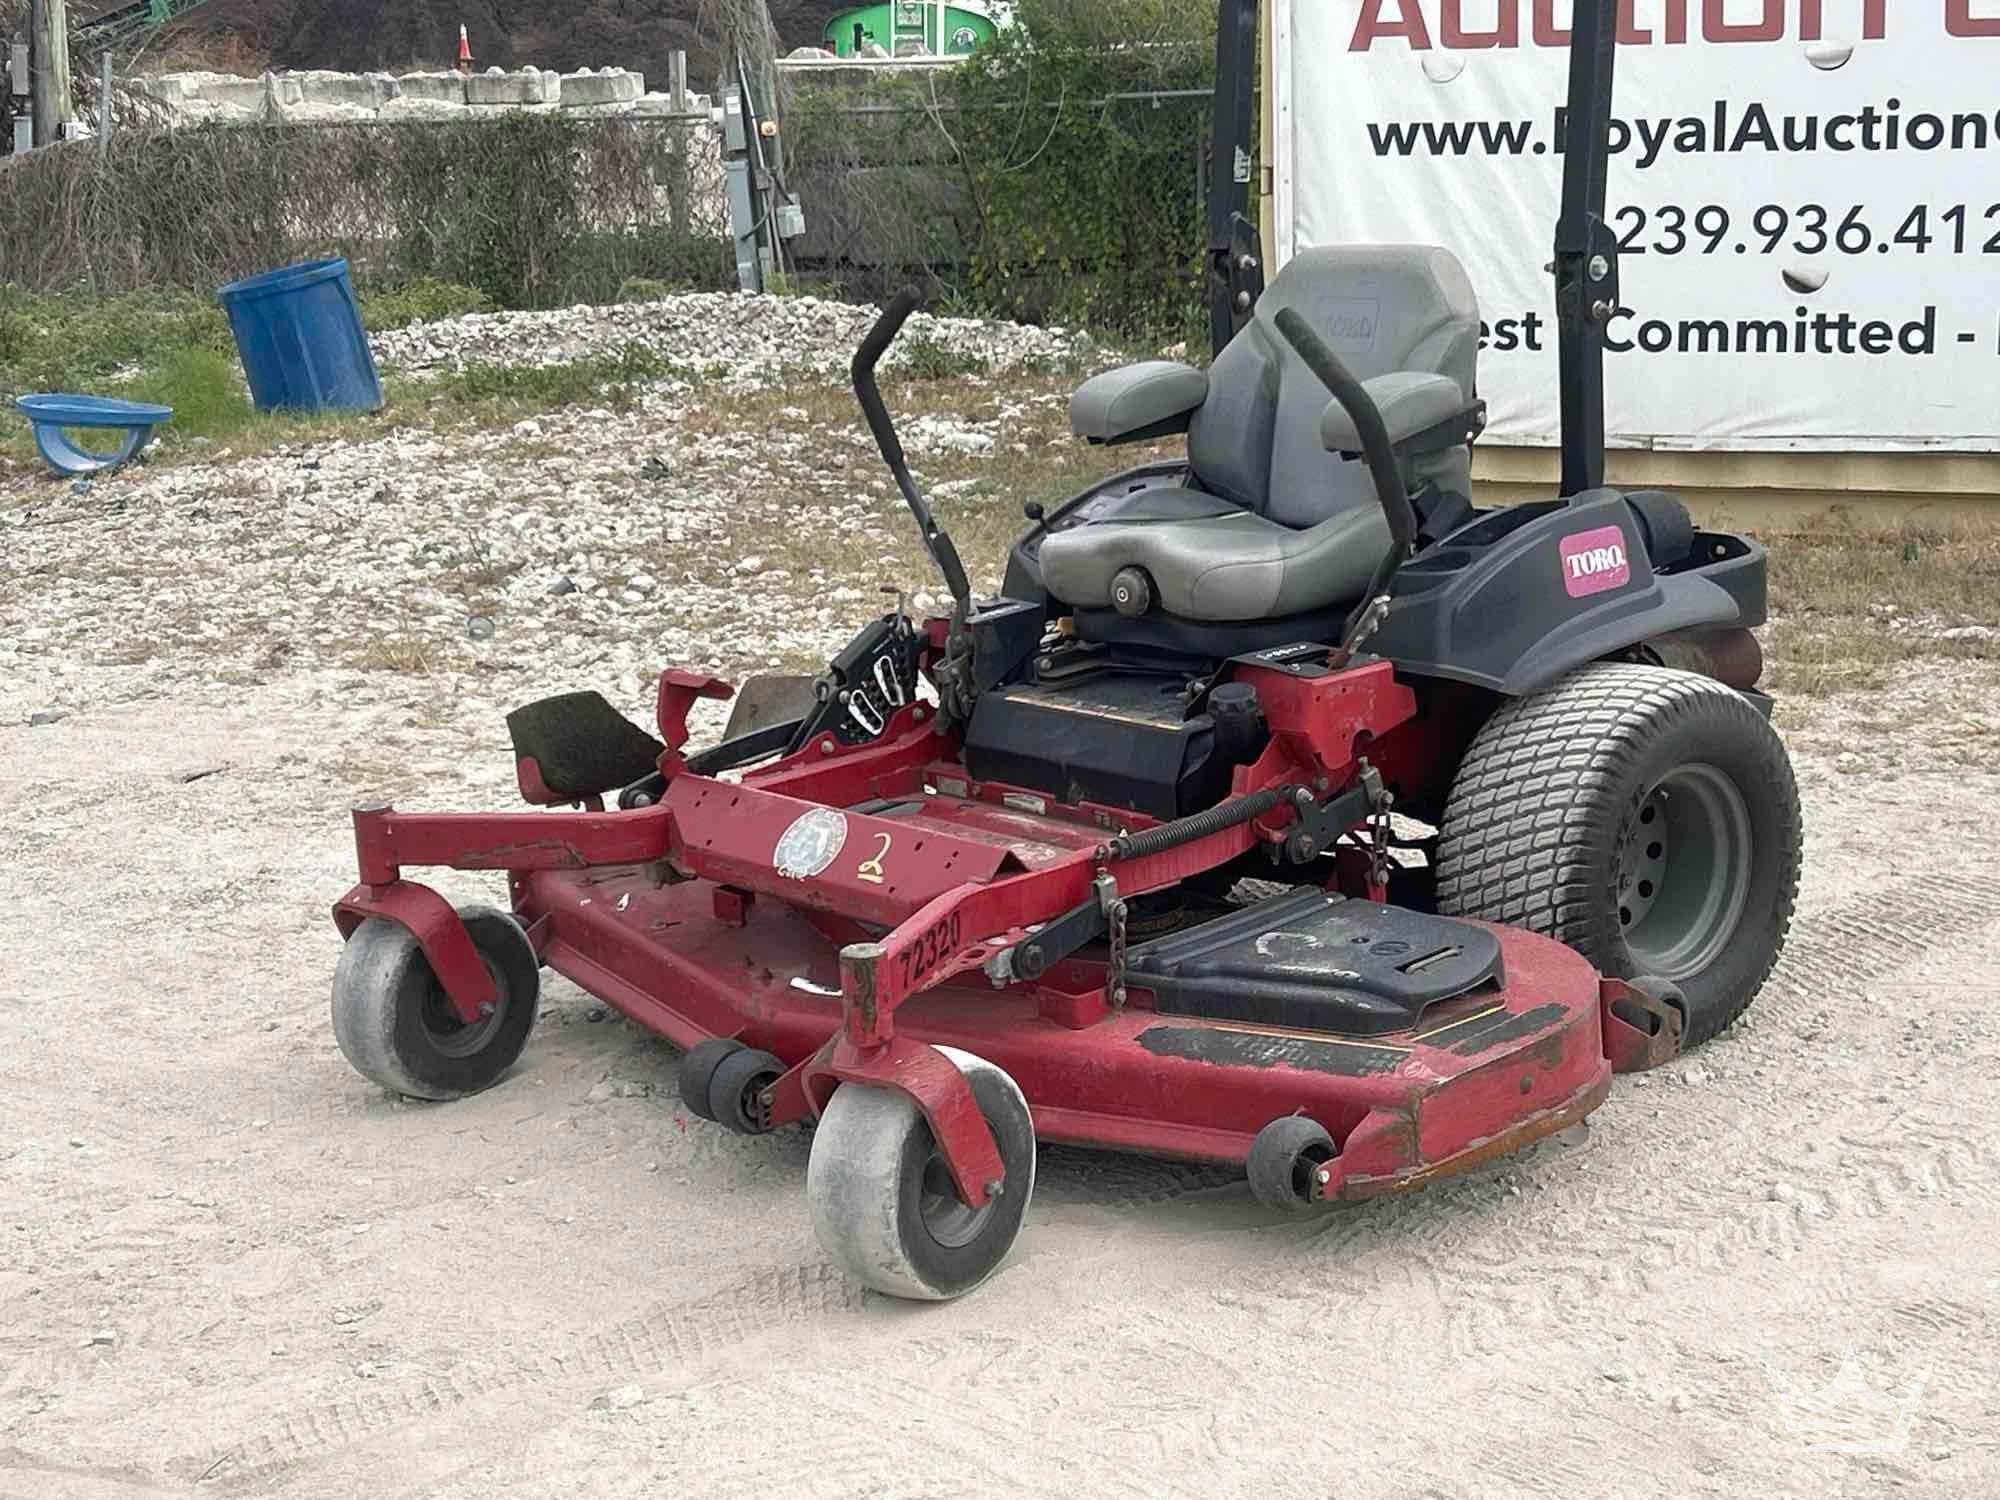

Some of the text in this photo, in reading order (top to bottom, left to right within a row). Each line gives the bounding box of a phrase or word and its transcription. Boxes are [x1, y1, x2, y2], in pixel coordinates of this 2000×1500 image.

[1366, 98, 2000, 169] www.oyalAuction
[1602, 306, 1936, 354] Committed
[900, 910, 960, 990] 72320
